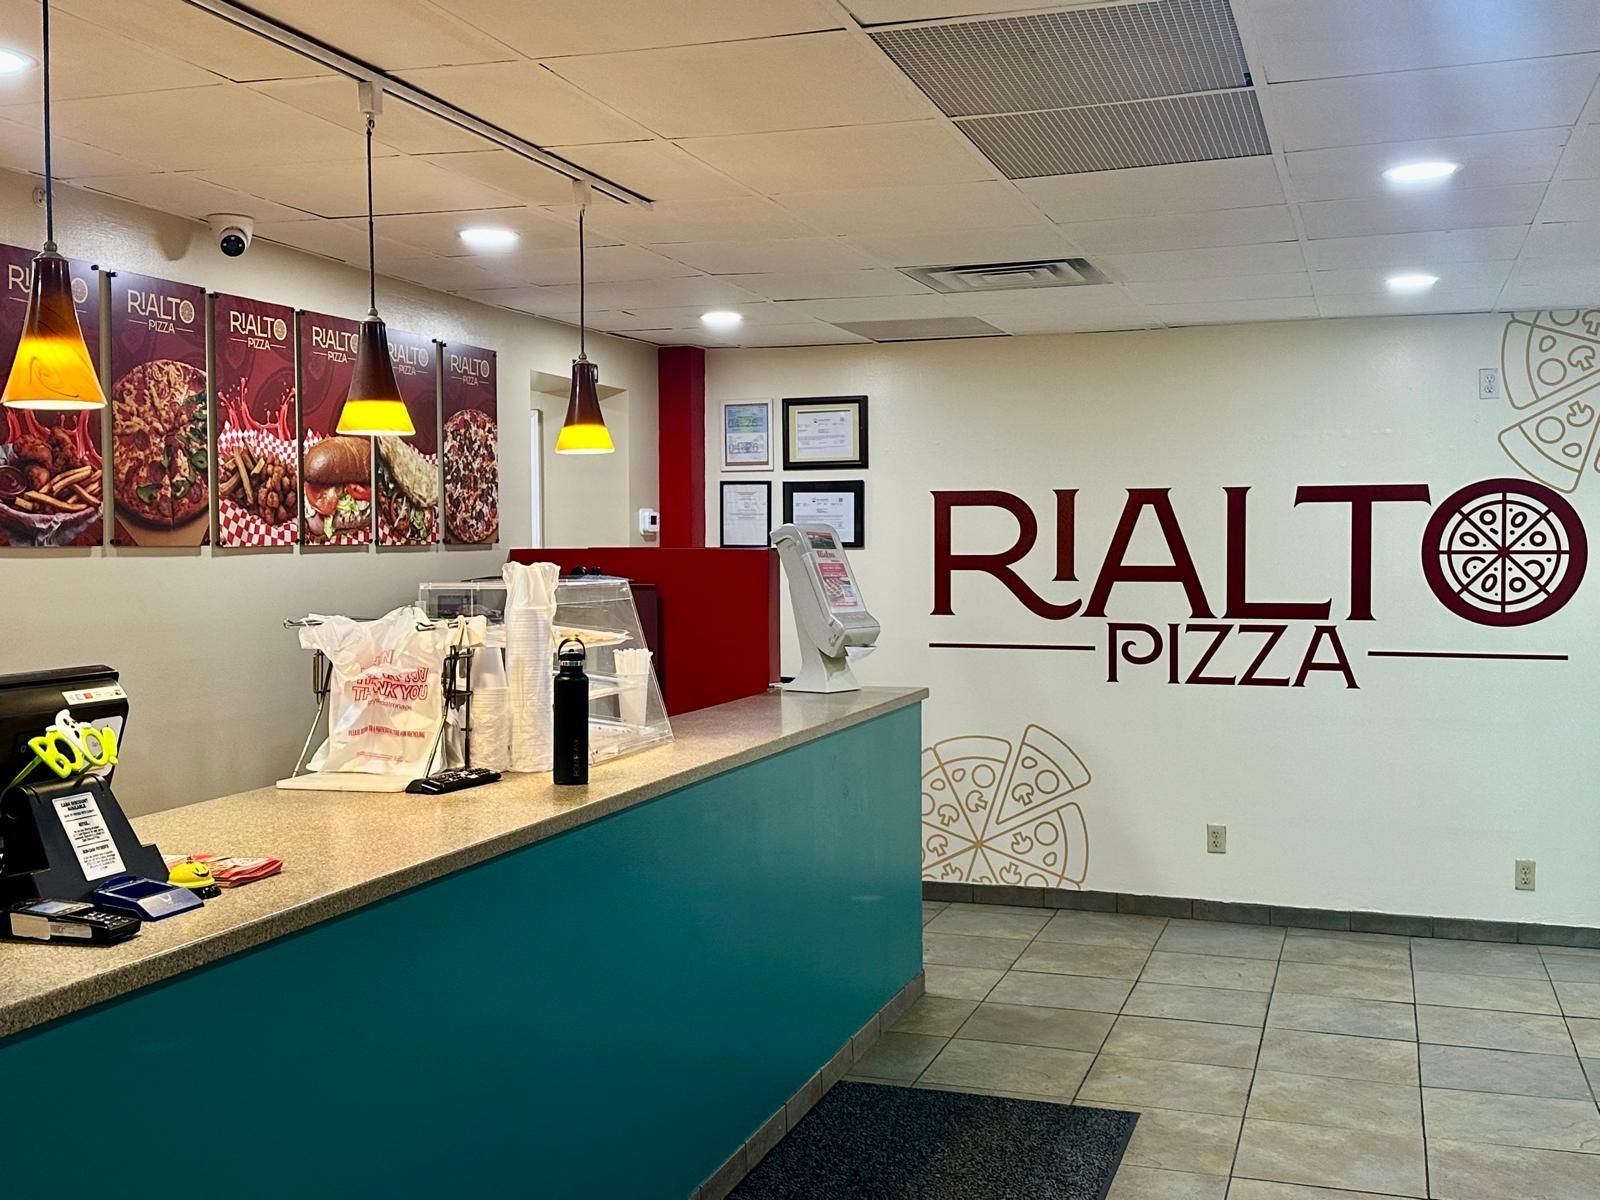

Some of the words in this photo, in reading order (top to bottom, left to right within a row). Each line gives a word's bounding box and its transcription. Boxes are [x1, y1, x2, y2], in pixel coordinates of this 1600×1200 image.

[127, 289, 195, 324] RIALTO
[148, 319, 176, 335] PIZZA
[229, 310, 287, 341] RIALTO
[247, 337, 271, 351] PIZZA
[327, 350, 348, 364] PIZZA
[398, 364, 417, 376] PIZZA
[450, 354, 490, 378] RIALTO
[462, 375, 479, 387] PIZZA
[929, 478, 1589, 627] RIALTO
[1105, 622, 1361, 690] PIZZA
[400, 684, 429, 701] YOU
